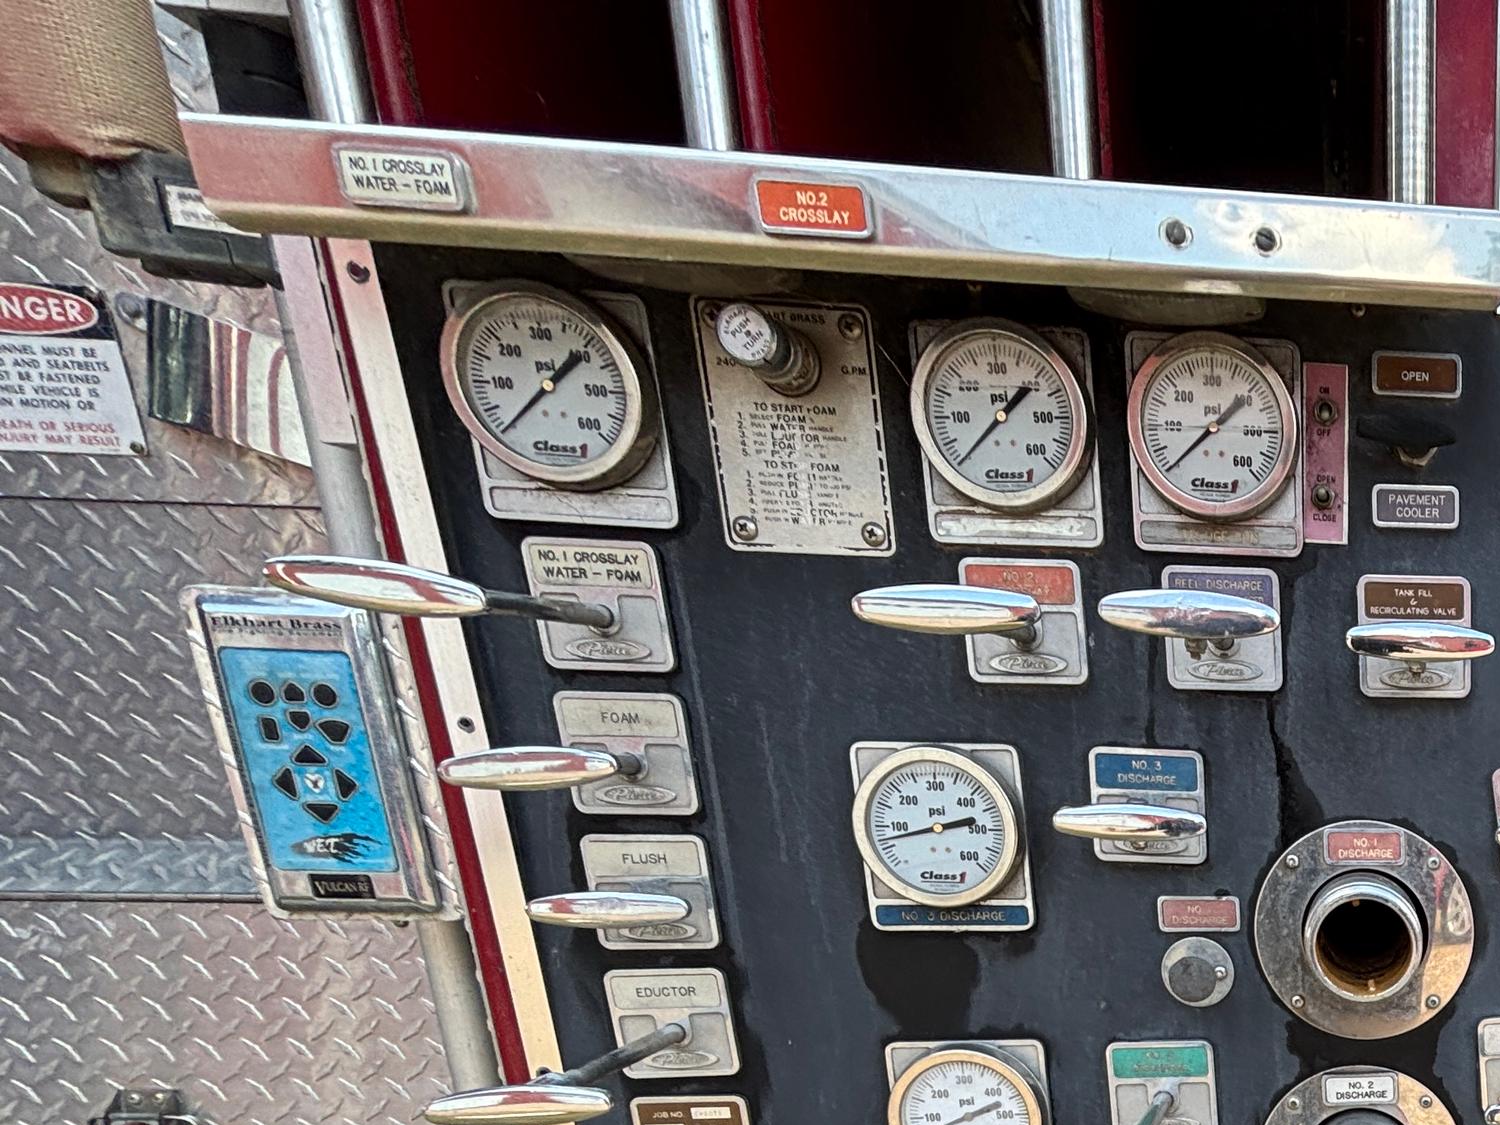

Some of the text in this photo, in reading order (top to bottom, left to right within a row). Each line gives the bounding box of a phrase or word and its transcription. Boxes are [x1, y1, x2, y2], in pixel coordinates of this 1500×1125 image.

[348, 156, 369, 171] NO.
[382, 159, 445, 177] CROSSLAY
[352, 175, 399, 192] WATER
[414, 180, 452, 195] FOAM
[779, 206, 850, 225] CROSSLAY
[528, 326, 552, 341] 300
[730, 317, 752, 338] PUSH
[743, 329, 764, 351] TURN
[41, 346, 97, 358] MUST BE
[13, 359, 110, 373] AND SEATBELTS
[40, 373, 101, 385] FASTENED
[1401, 370, 1430, 382] OPEN
[33, 387, 82, 398] VEHICLE
[1173, 390, 1194, 403] 200
[20, 399, 96, 411] MOTION OR
[753, 402, 769, 412] TO
[770, 403, 804, 415] START
[64, 422, 116, 434] SERIOUS
[1317, 428, 1331, 437] OFF
[45, 435, 120, 448] MAY RESULT
[1316, 474, 1336, 484] OPEN
[1388, 493, 1446, 506] PAVEMENT
[1312, 513, 1337, 523] CLOSE
[1396, 506, 1440, 518] COOLER
[538, 549, 560, 562] NO.
[574, 551, 639, 566] CROSSLAY
[543, 566, 588, 580] WATER
[606, 568, 642, 584] FOAM
[1206, 579, 1264, 591] DISCHARGE
[1393, 587, 1433, 598] TANK FILL
[1370, 605, 1457, 616] RECIRCULATING VALVE
[210, 615, 343, 632] Elkhart Brass
[601, 711, 640, 724] FOAM
[1132, 760, 1162, 771] NO. 3
[1117, 773, 1177, 785] DISCHARGE
[1353, 837, 1372, 847] NO.
[622, 853, 668, 865] FLUSH
[959, 850, 979, 861] 600
[1338, 847, 1394, 859] DISCHARGE
[927, 911, 936, 921] 3
[940, 911, 1006, 922] DISCHARGE
[636, 986, 697, 998] EDUCTOR
[1348, 1080, 1375, 1090] NO. 2
[931, 1088, 949, 1099] 200
[1336, 1089, 1388, 1100] DISCHARGE
